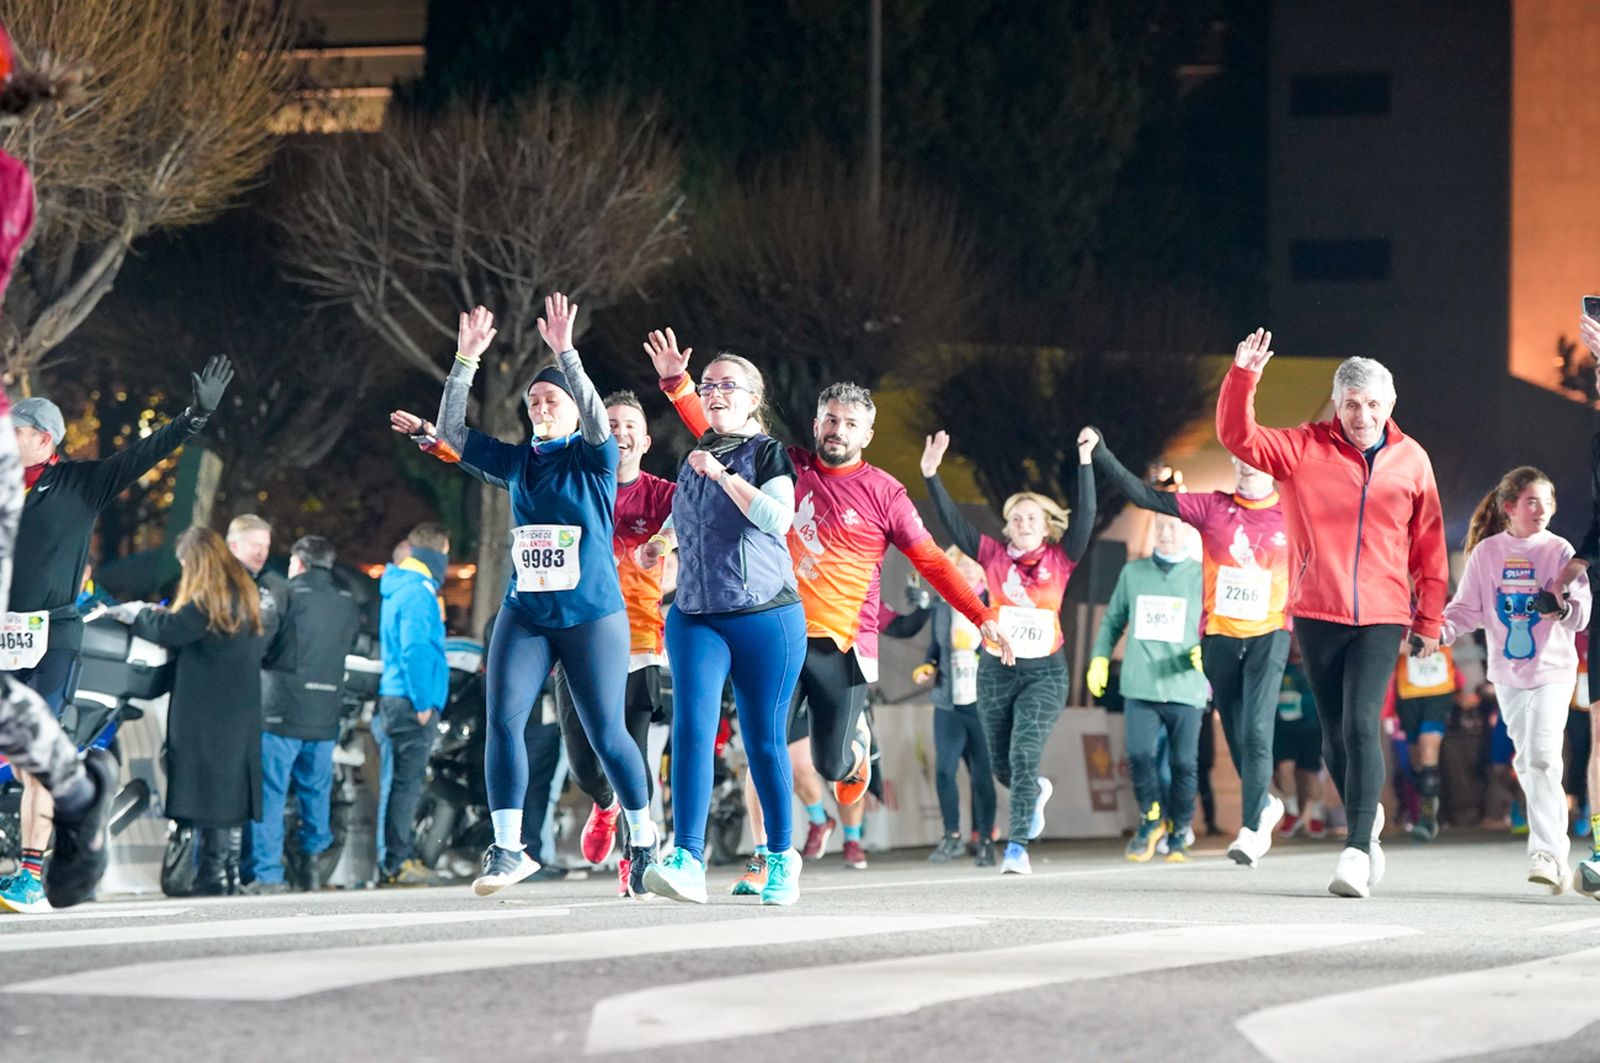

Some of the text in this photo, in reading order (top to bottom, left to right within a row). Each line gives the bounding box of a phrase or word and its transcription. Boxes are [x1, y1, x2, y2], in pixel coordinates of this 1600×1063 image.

[800, 524, 815, 541] 43
[522, 549, 565, 568] 9983
[1226, 585, 1259, 602] 2266
[0, 633, 33, 649] 4643
[1011, 625, 1042, 640] 2267
